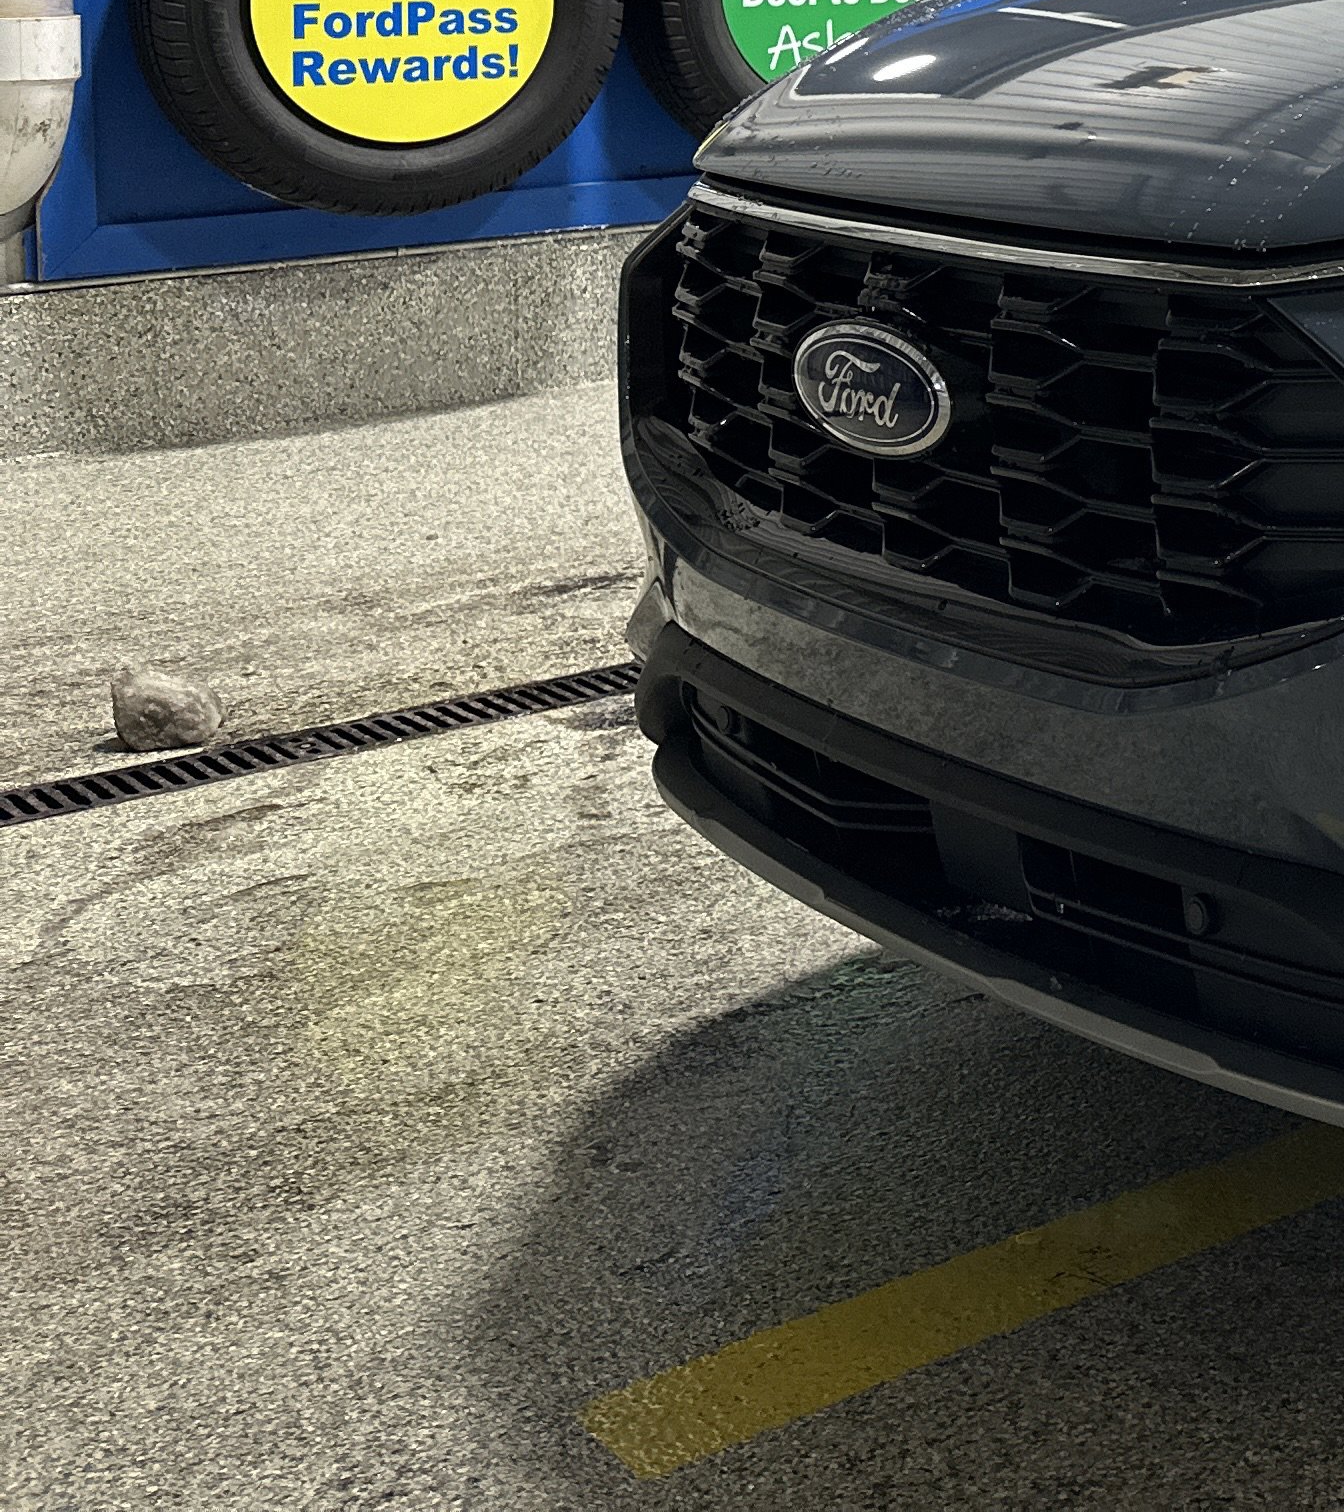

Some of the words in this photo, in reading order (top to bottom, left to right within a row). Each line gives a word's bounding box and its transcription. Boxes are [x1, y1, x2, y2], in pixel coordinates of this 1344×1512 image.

[293, 1, 518, 39] FordPass
[293, 44, 518, 87] Rewards!
[819, 349, 901, 430] Ford
